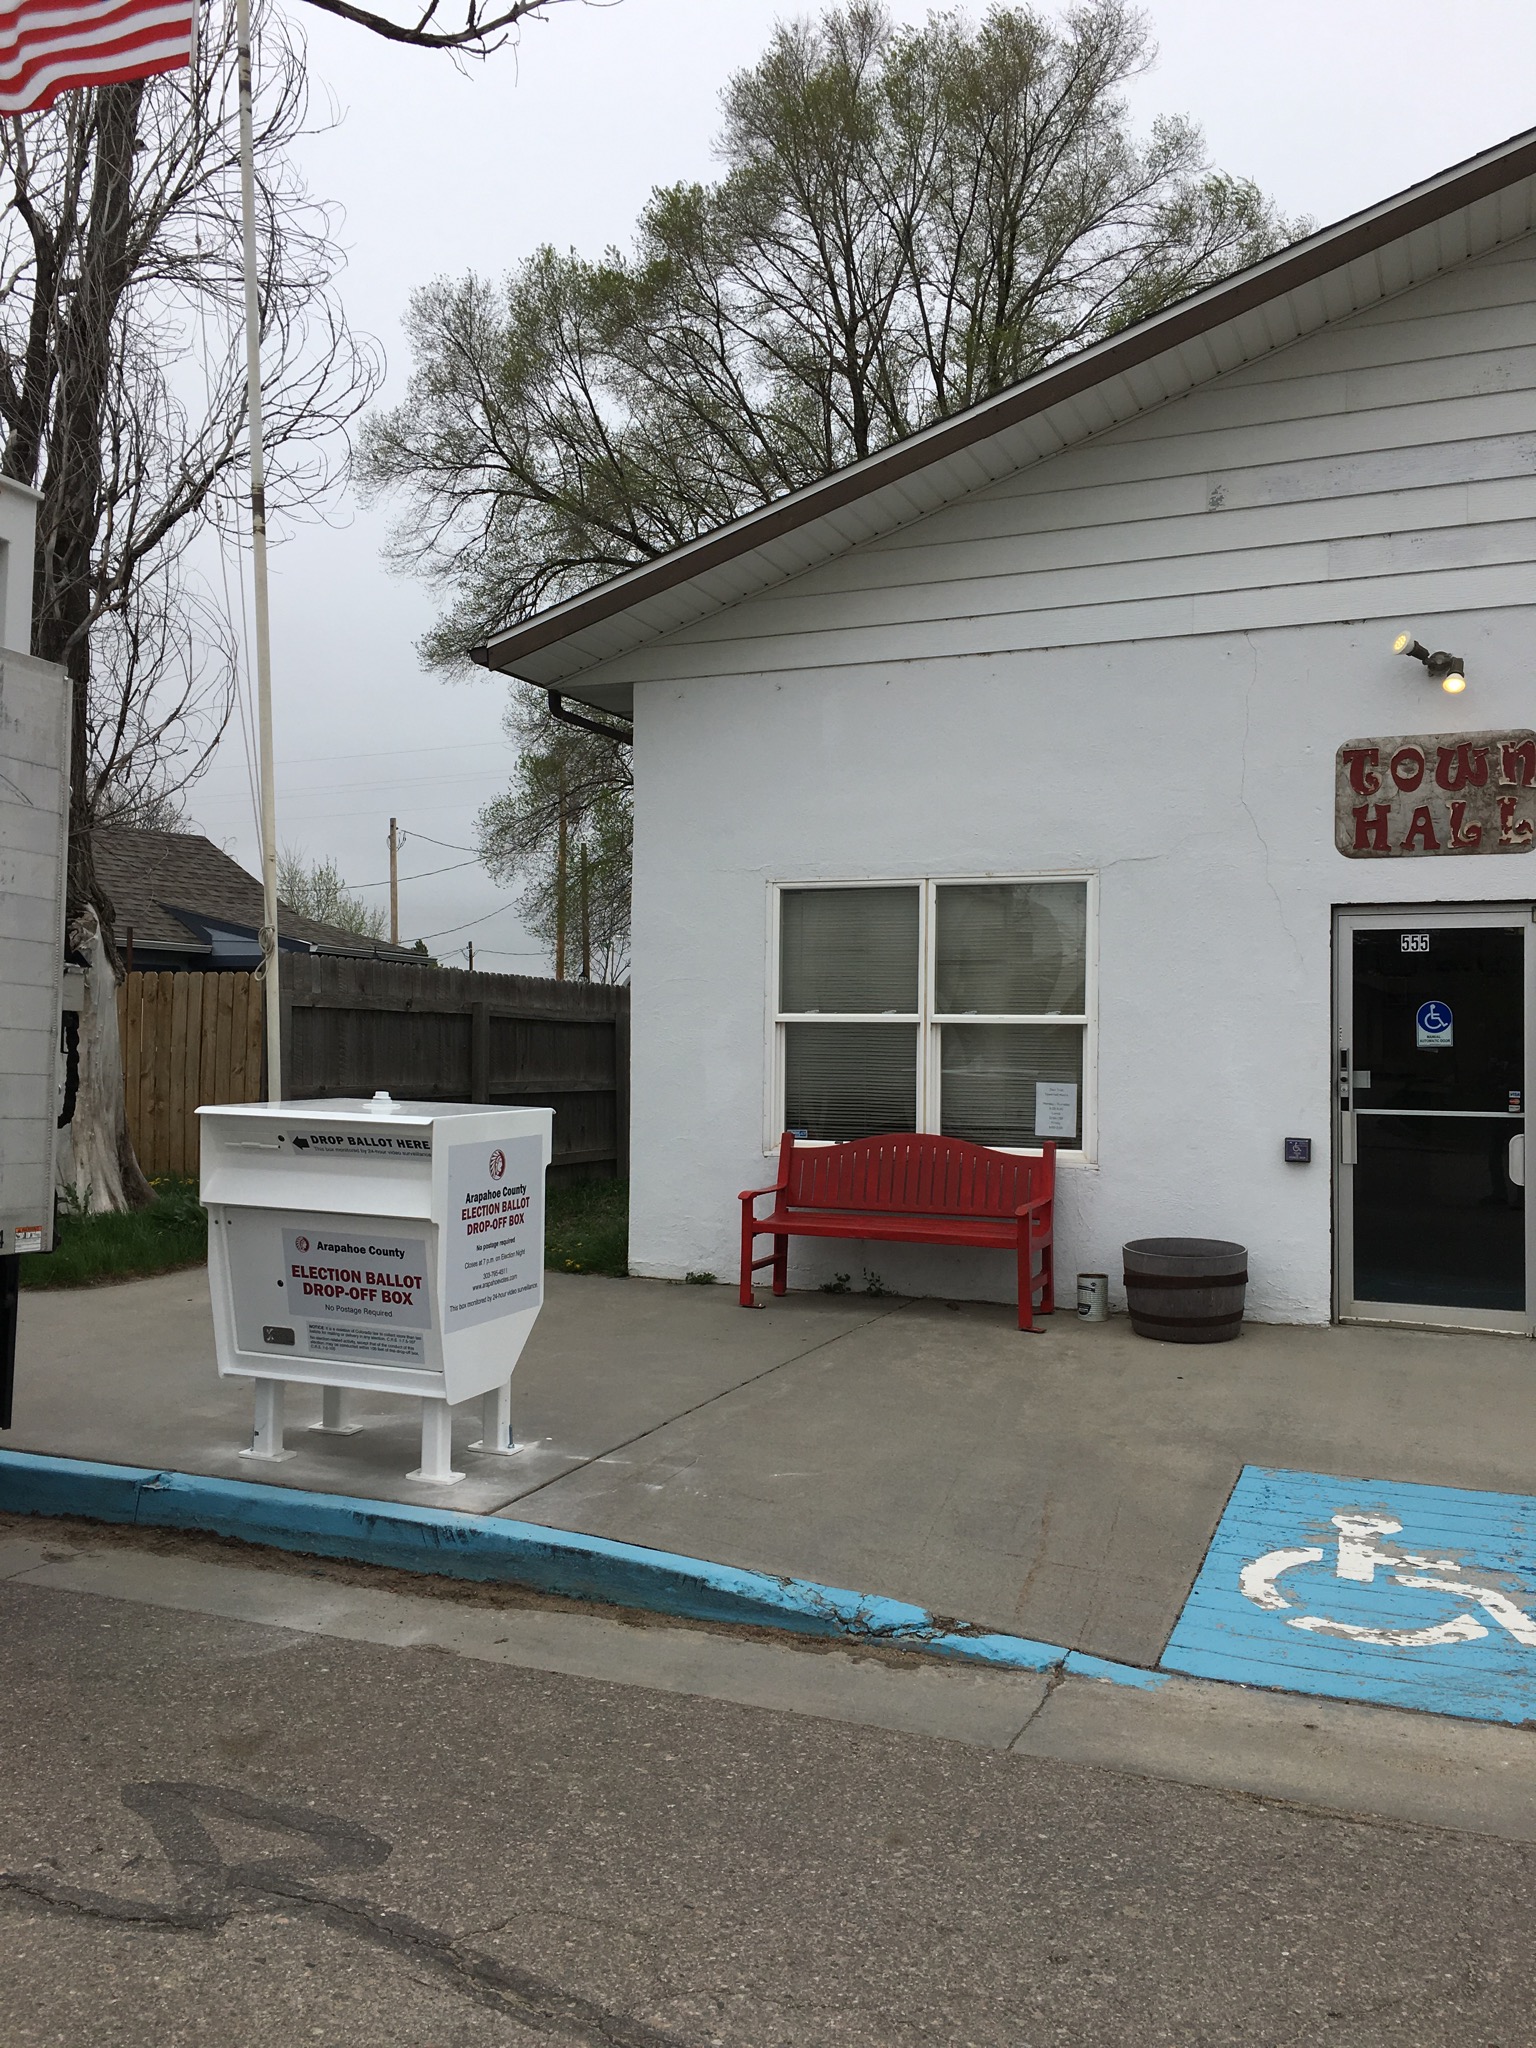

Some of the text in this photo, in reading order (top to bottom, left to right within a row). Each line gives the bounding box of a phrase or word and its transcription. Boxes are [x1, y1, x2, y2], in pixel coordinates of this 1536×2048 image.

[1343, 739, 1536, 795] TOWN
[1352, 796, 1534, 851] HALL
[1402, 935, 1428, 951] 555
[310, 1135, 430, 1150] DROP BALLOT HERE
[466, 1184, 526, 1204] Arapahoe County
[461, 1197, 530, 1221] ELECTION BALLOT
[467, 1213, 525, 1236] DROP-OFF BOX
[317, 1241, 405, 1259] Arapahoe County
[483, 1241, 499, 1251] postage
[499, 1237, 516, 1247] required
[292, 1264, 422, 1289] ELECTION BALLOT
[303, 1282, 413, 1305] DROP-OFF BOX
[336, 1305, 361, 1315] Postage
[364, 1308, 392, 1317] Required
[449, 1304, 458, 1312] This
